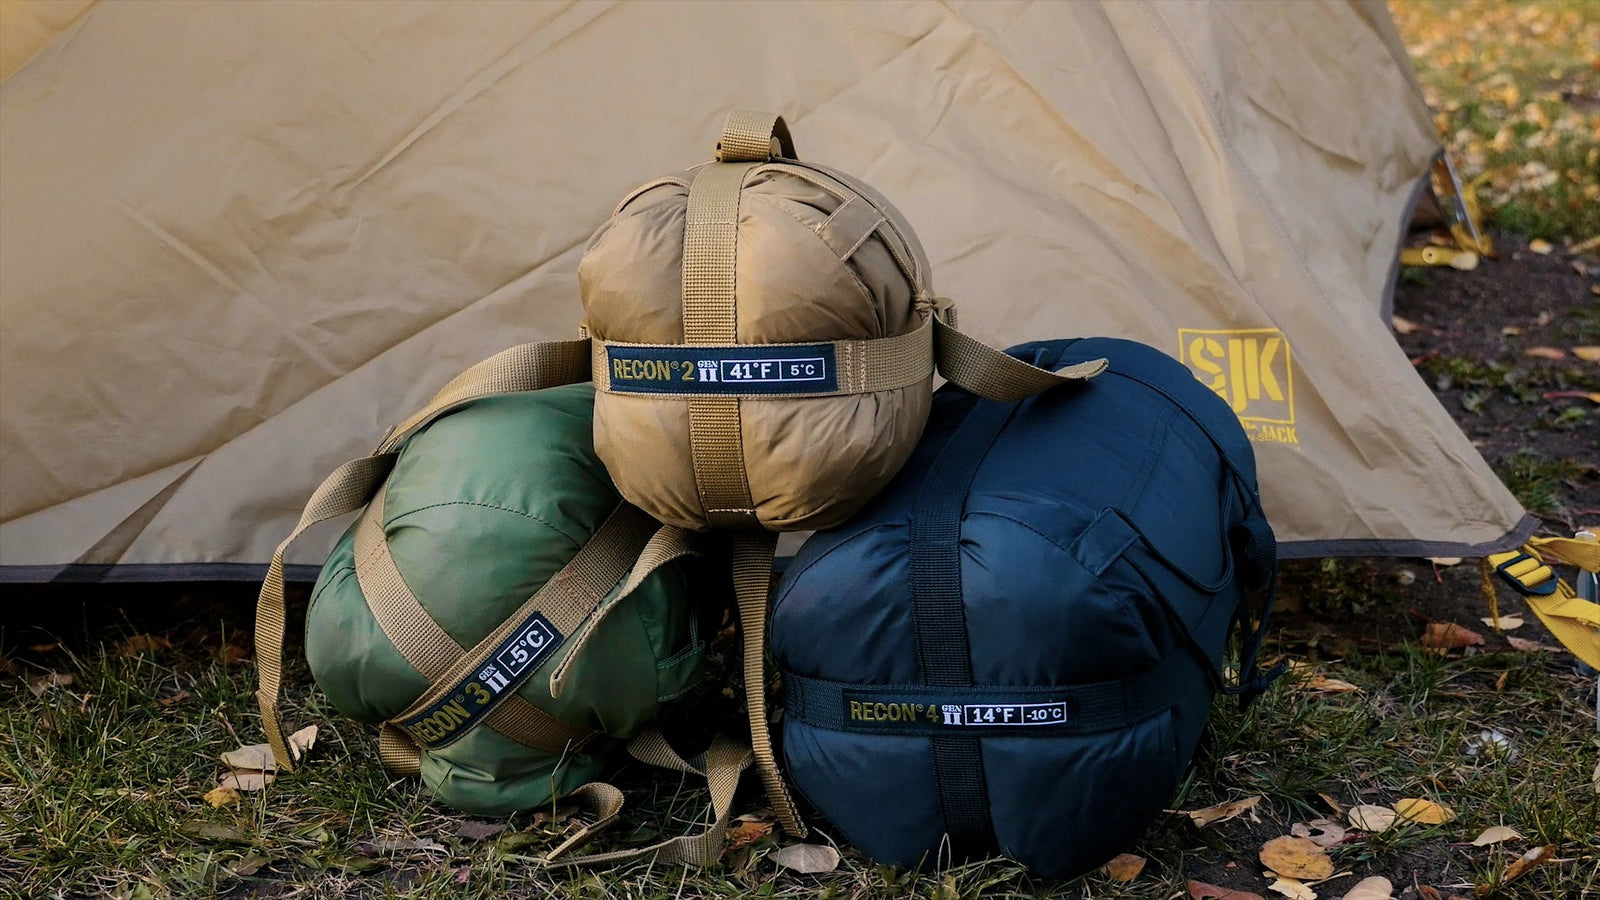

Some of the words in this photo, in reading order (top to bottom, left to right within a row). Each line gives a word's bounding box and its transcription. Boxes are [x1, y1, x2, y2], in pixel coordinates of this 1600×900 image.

[682, 360, 695, 381] 2
[697, 360, 718, 368] GEN
[730, 361, 772, 379] 41°F
[790, 363, 815, 376] 5°C
[698, 368, 718, 382] II
[1189, 337, 1285, 413] SJK
[510, 630, 544, 666] -5°C
[478, 663, 497, 681] GEN
[485, 670, 510, 694] II
[466, 682, 491, 705] 3
[925, 704, 939, 722] 4
[943, 712, 962, 725] II
[973, 707, 1014, 723] 14°F
[1026, 708, 1062, 721] -10°C
